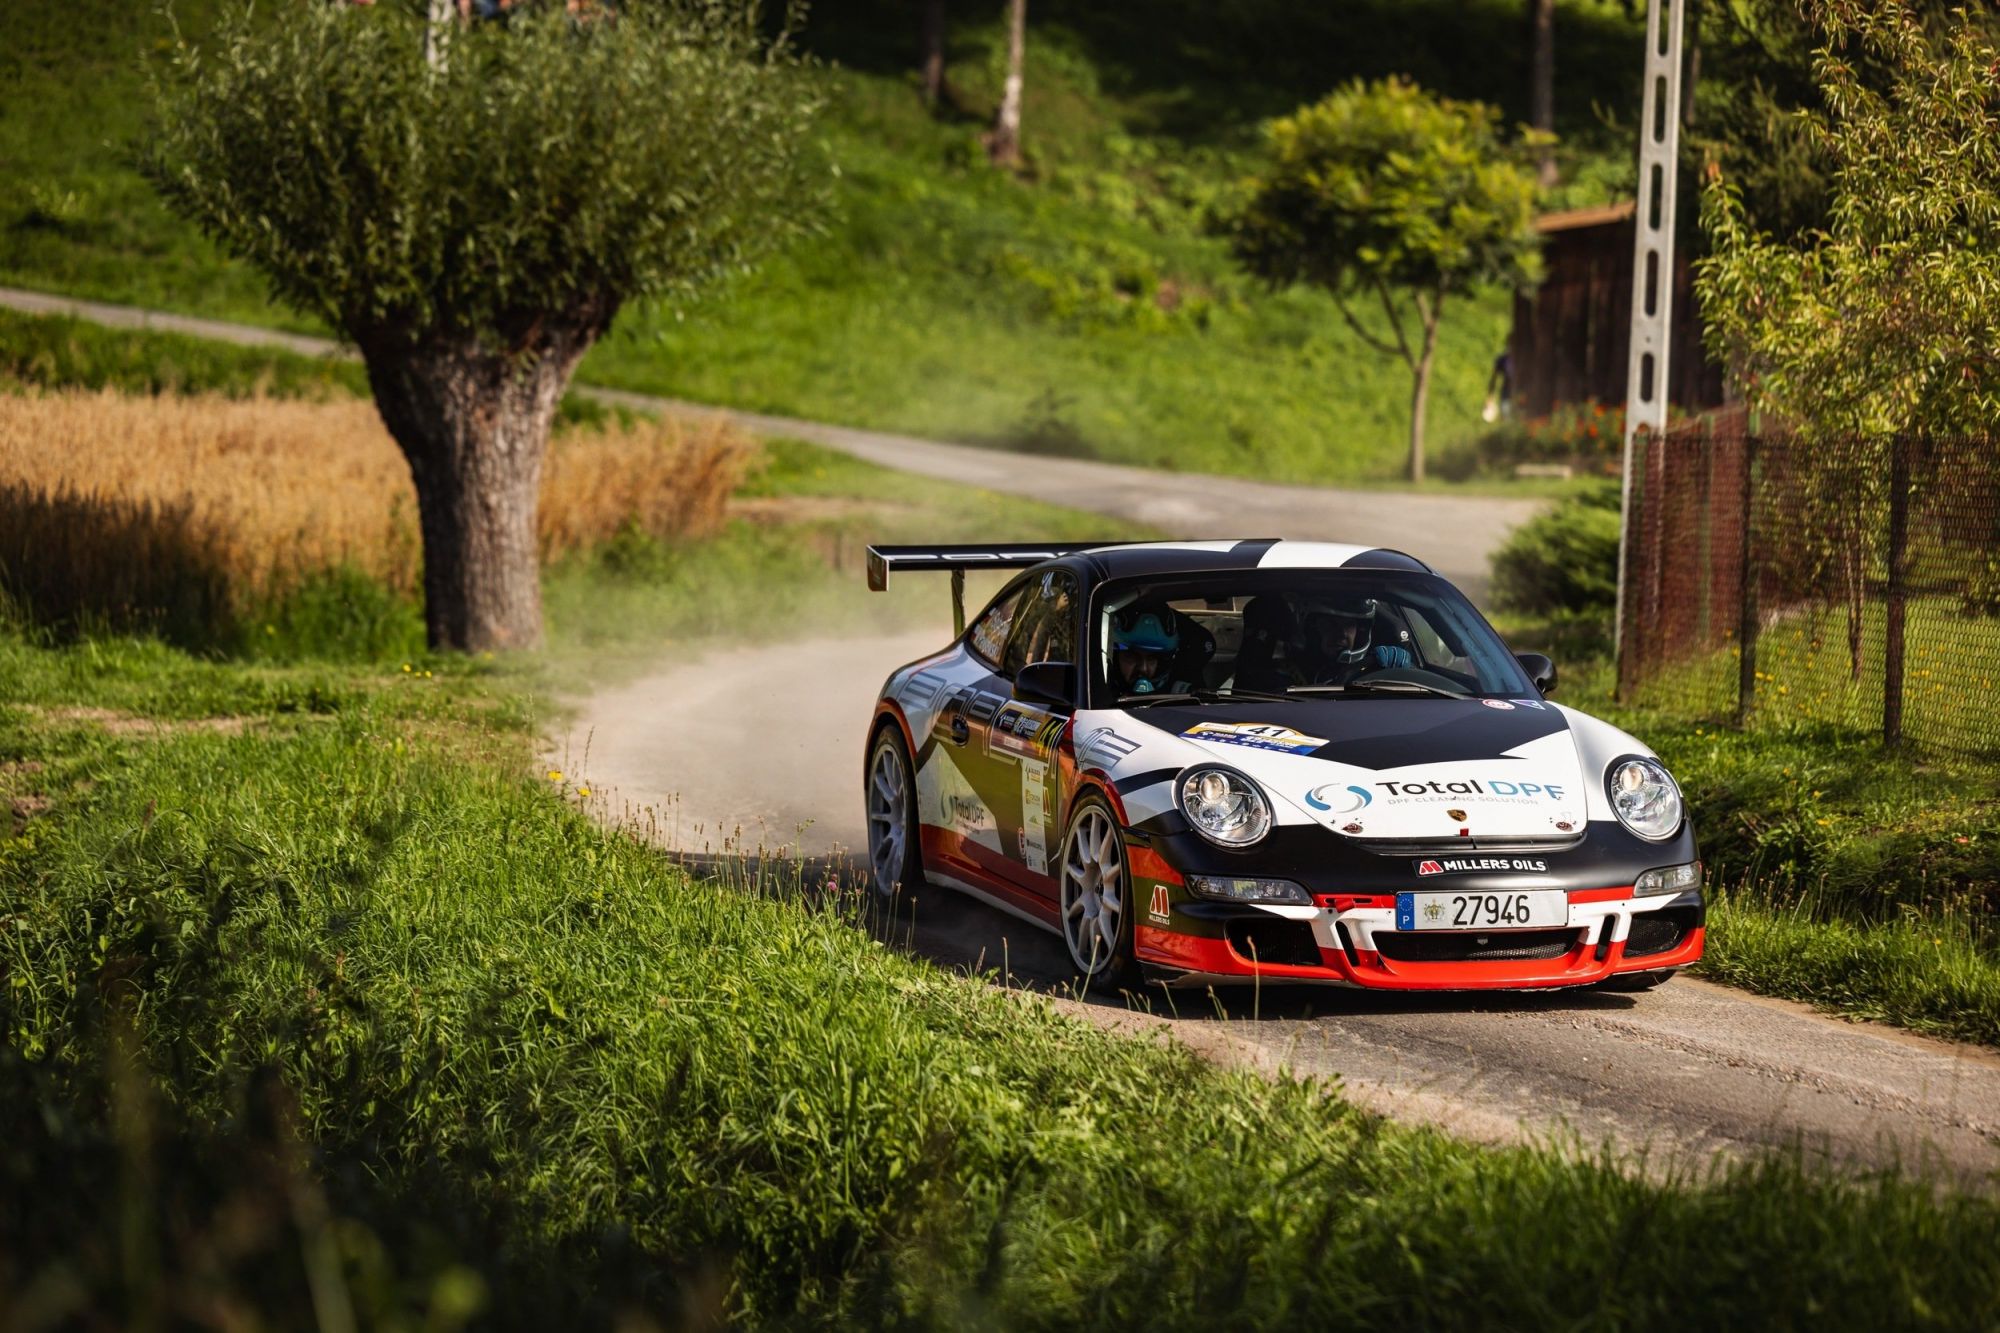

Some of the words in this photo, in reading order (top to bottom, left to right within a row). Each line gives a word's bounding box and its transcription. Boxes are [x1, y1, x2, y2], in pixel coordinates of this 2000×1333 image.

[1247, 726, 1287, 737] 41
[1375, 779, 1484, 796] Total
[1488, 780, 1565, 799] DPF
[1477, 796, 1539, 805] SOLUTION
[1443, 859, 1510, 871] MILLERS
[1513, 860, 1547, 872] OILS
[1452, 894, 1531, 926] 27946
[1402, 916, 1410, 925] P
